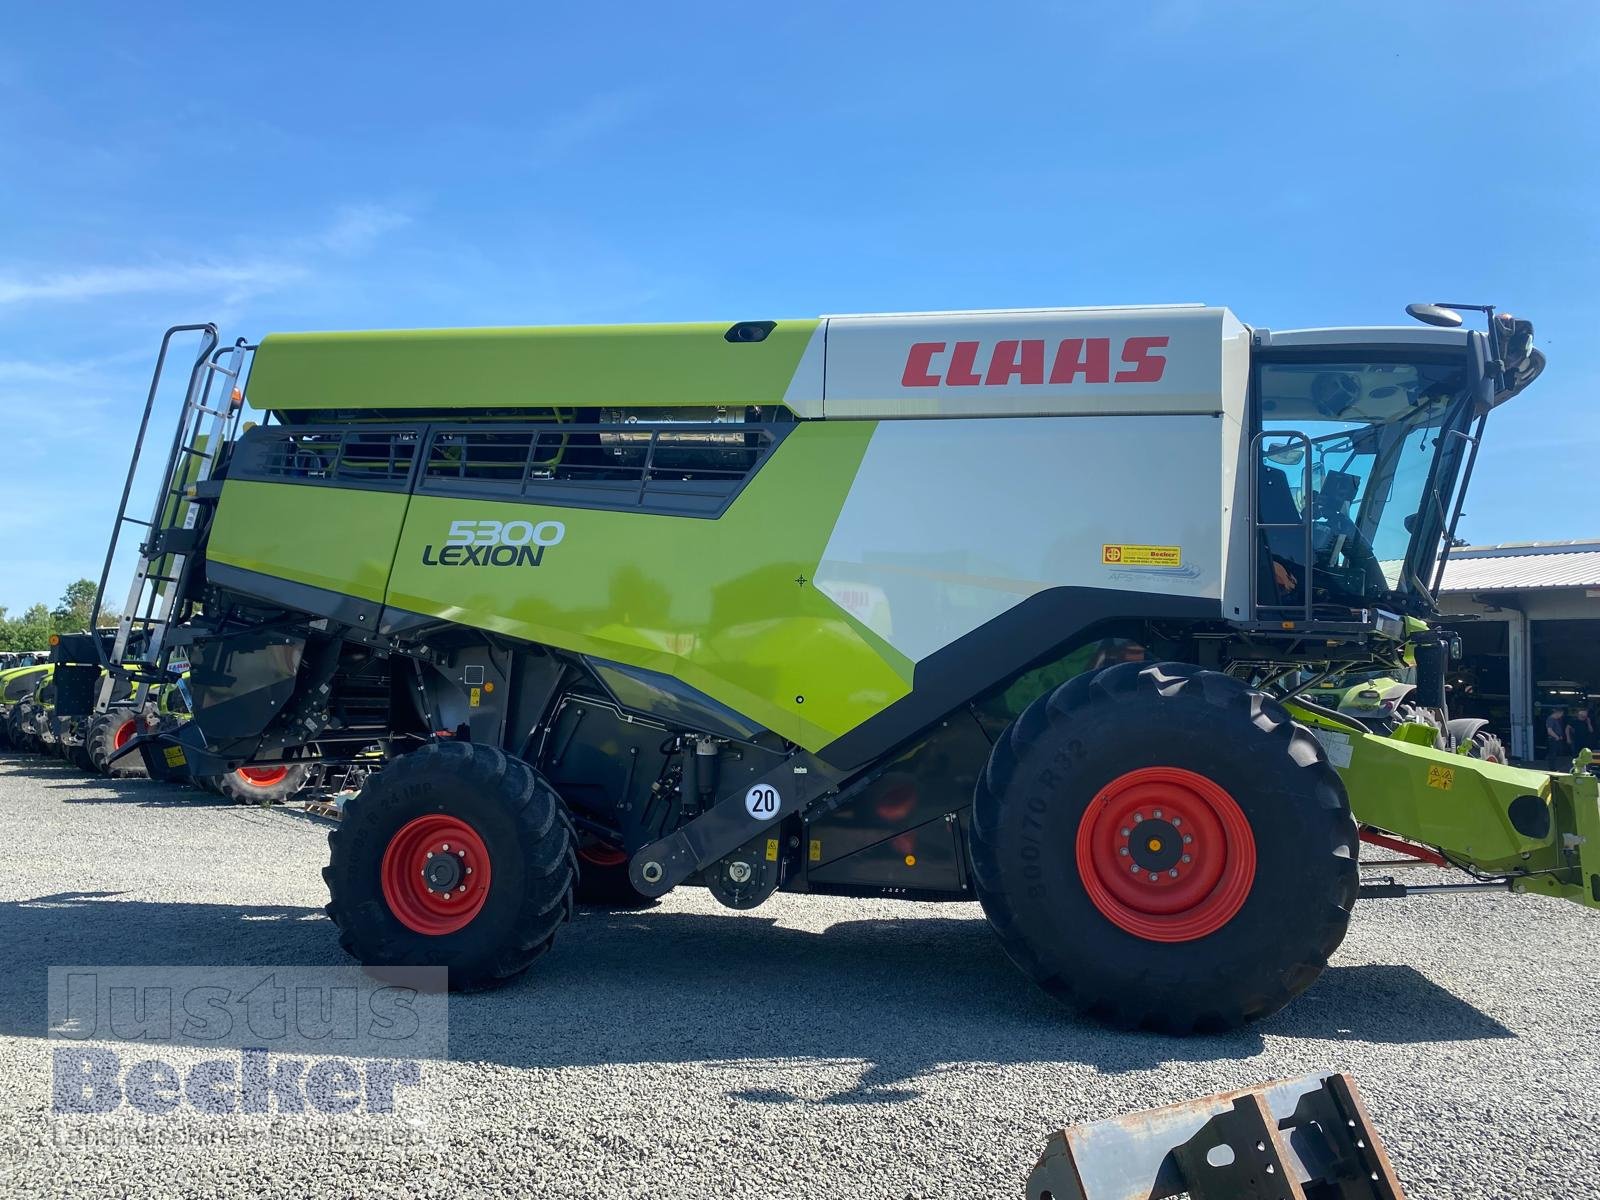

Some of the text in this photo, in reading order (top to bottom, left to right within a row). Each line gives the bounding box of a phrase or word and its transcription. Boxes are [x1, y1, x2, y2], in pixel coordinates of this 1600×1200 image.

[901, 336, 1170, 387] CLAAS
[447, 520, 566, 547] 5300
[422, 545, 545, 567] LEXION
[752, 790, 775, 812] 20
